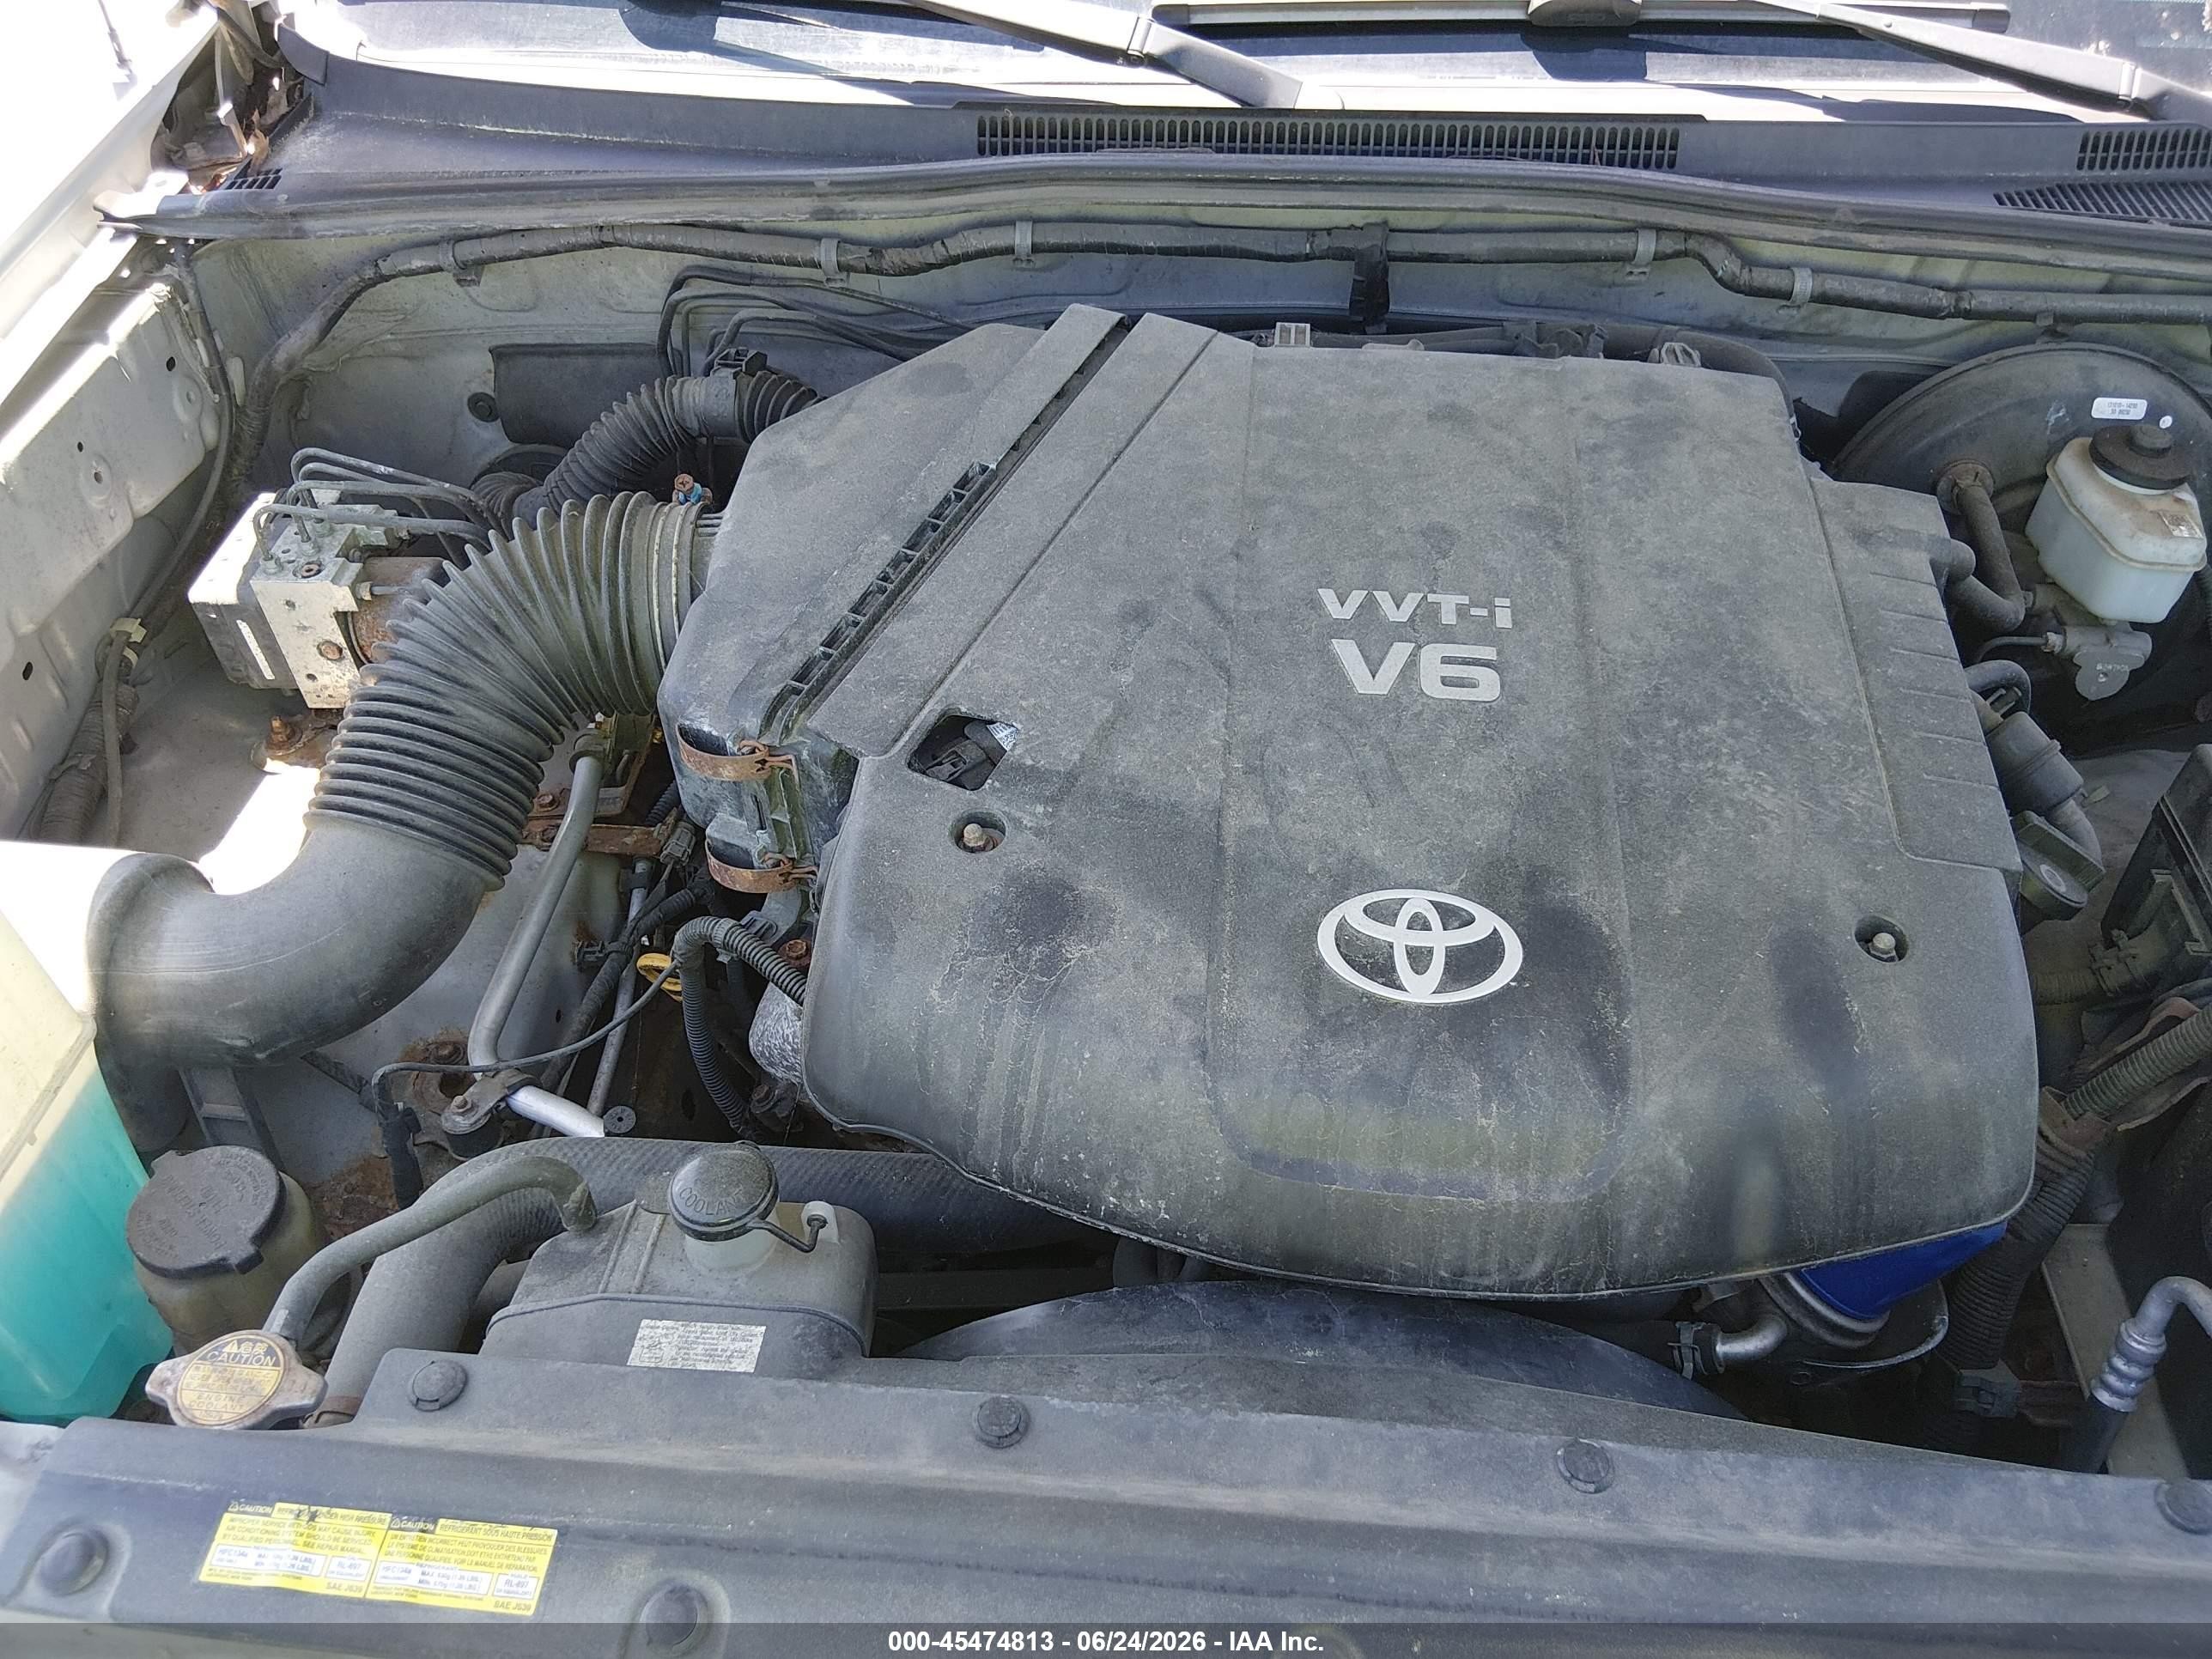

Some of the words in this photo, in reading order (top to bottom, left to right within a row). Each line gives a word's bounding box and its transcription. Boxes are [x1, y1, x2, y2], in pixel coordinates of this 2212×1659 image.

[1317, 588, 1512, 629] VVT-i
[1331, 638, 1501, 702] V6
[679, 1183, 744, 1216] COOLANT
[207, 1351, 276, 1367] CAUTION
[238, 1504, 272, 1513] CAUTION
[401, 1520, 434, 1529] CAUTION
[325, 1582, 343, 1590] SAE
